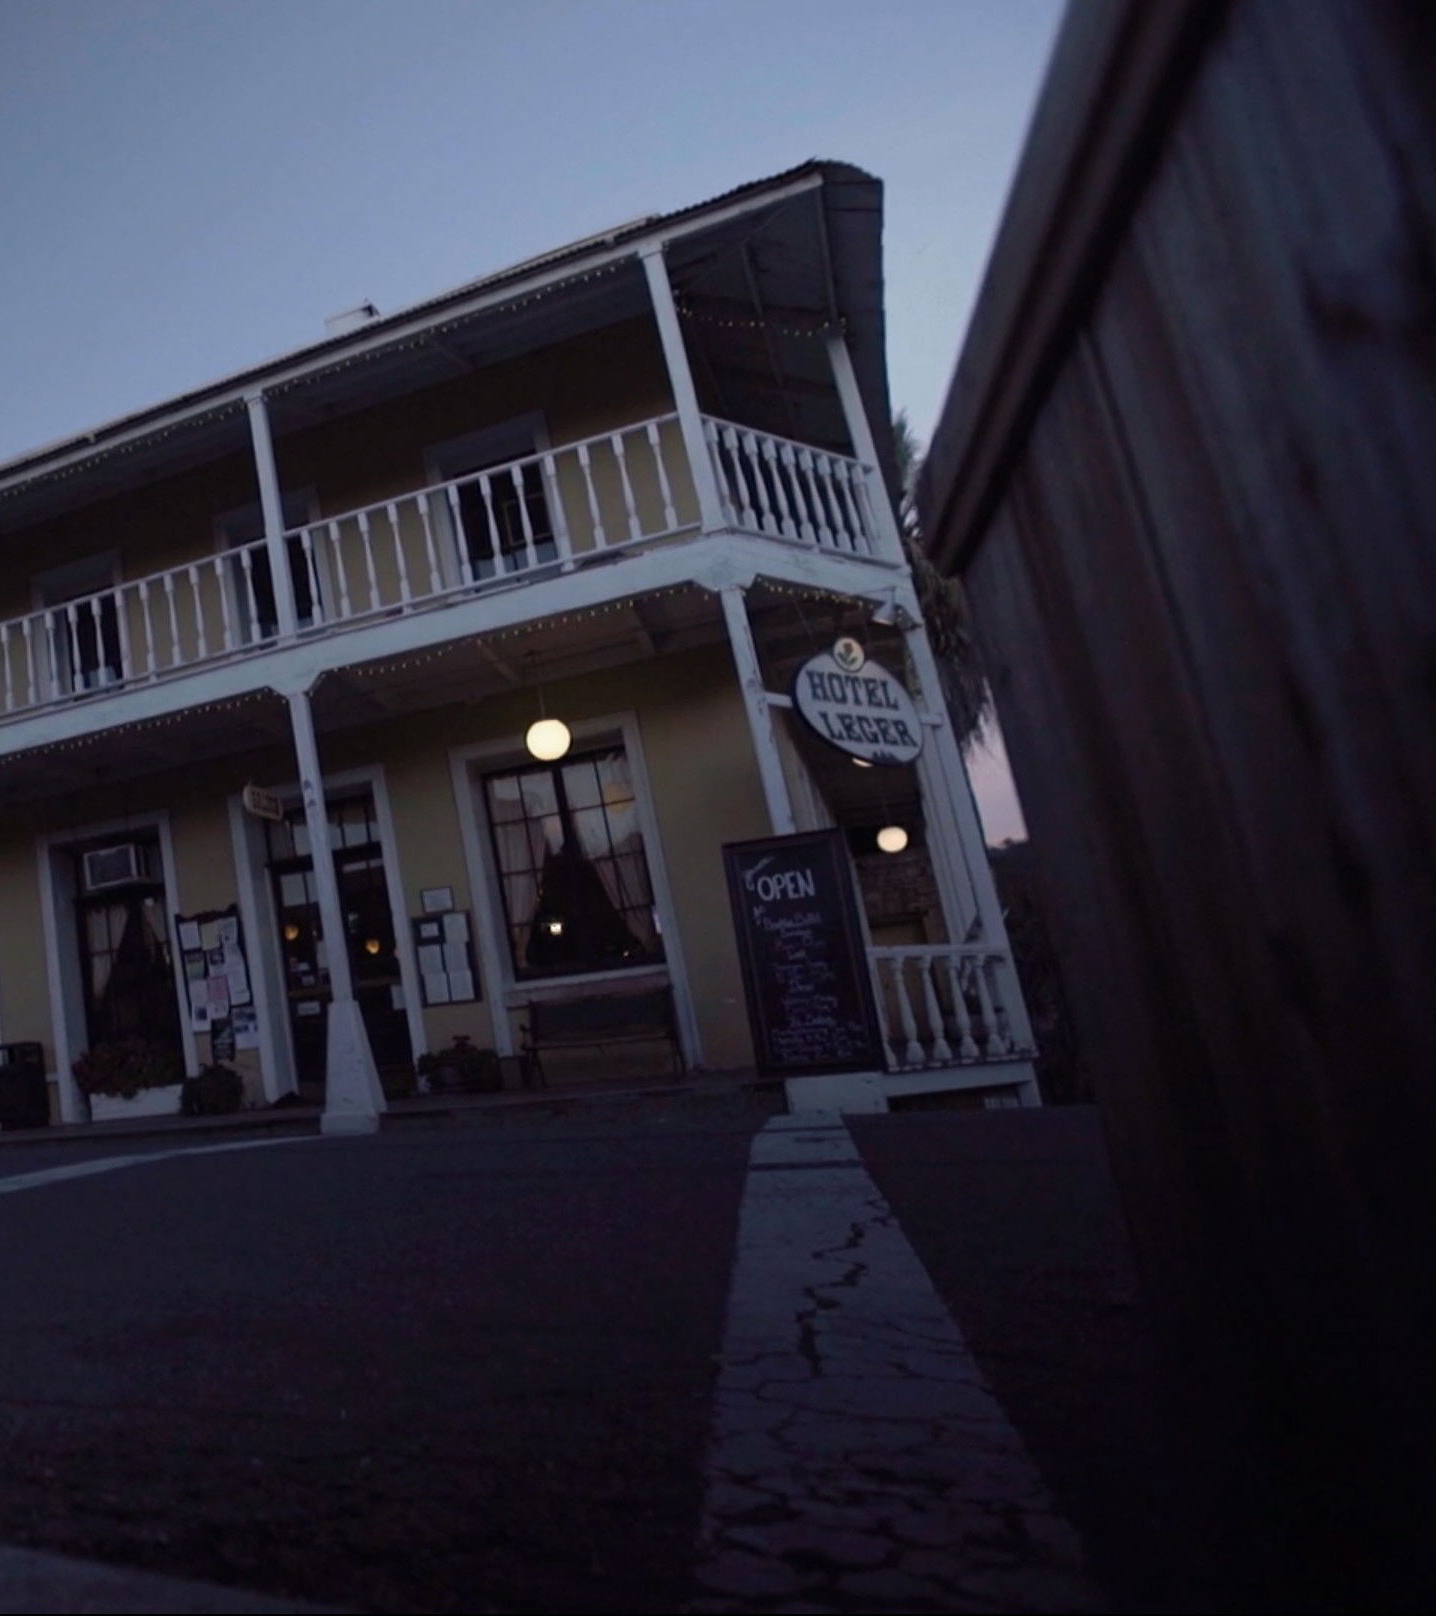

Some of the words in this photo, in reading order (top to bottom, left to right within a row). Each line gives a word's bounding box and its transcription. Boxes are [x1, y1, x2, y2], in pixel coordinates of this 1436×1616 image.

[806, 671, 899, 711] HOTEL
[818, 711, 918, 748] LEGER
[756, 868, 816, 902] OPEN
